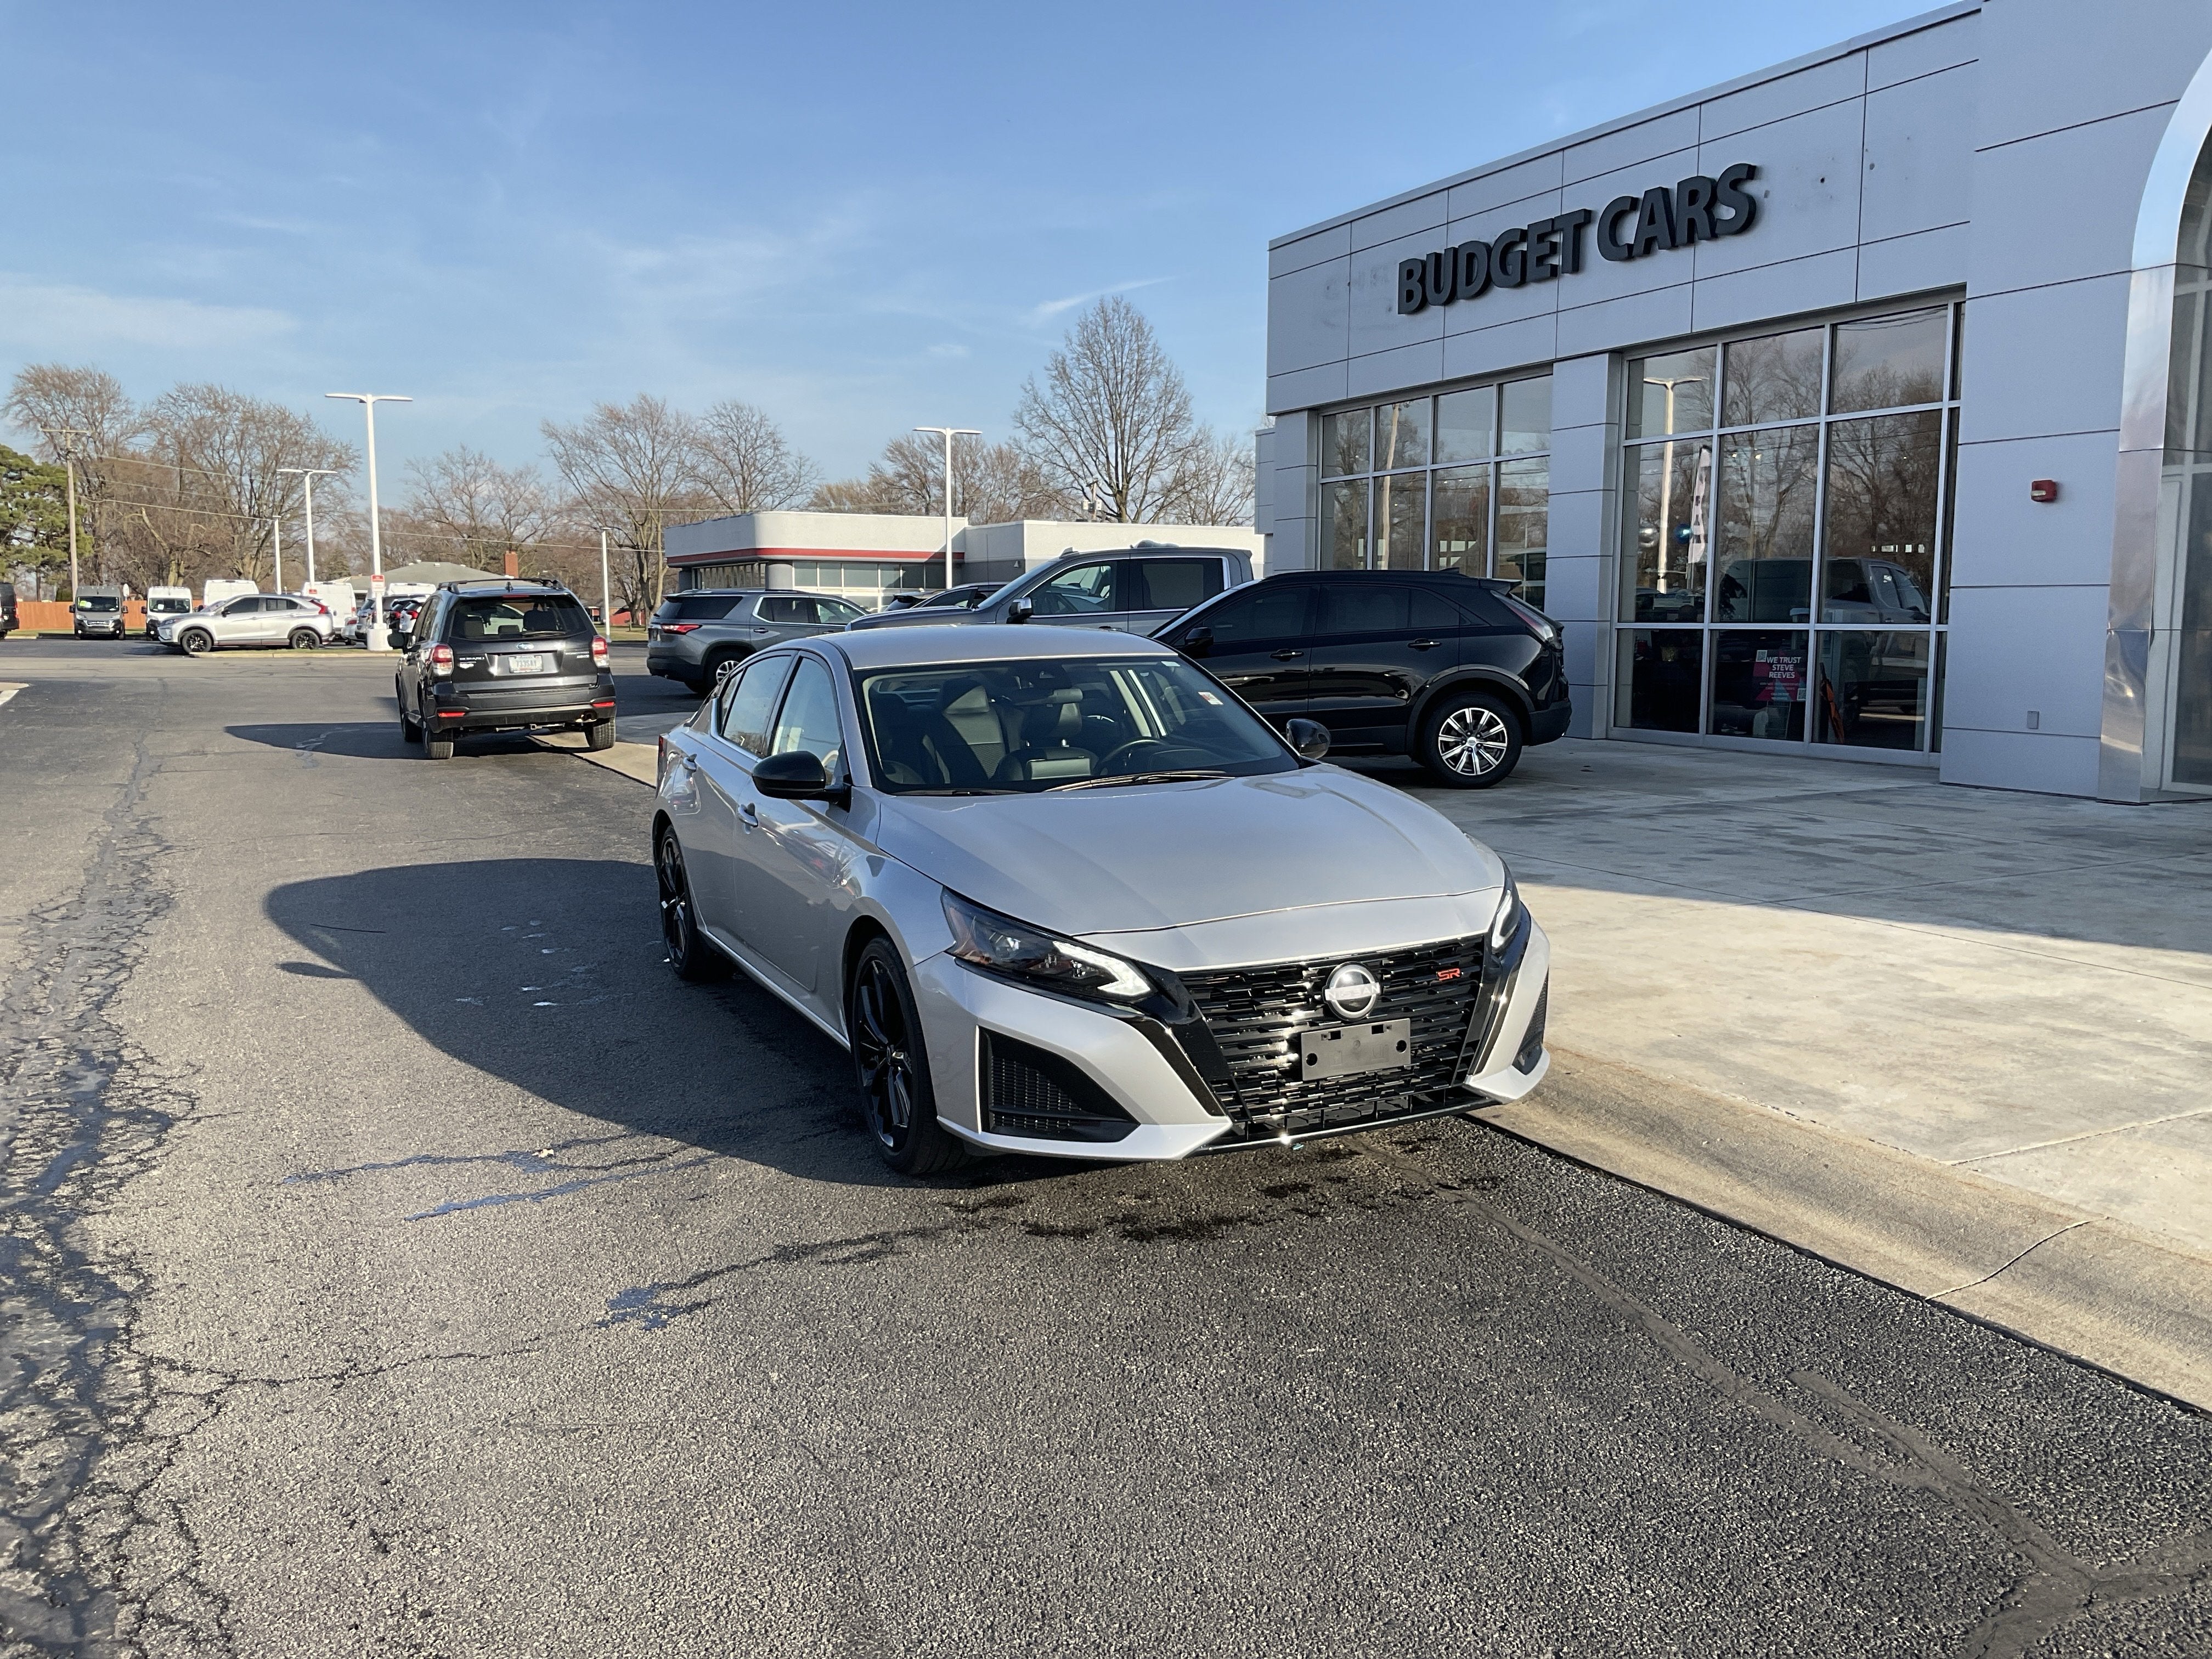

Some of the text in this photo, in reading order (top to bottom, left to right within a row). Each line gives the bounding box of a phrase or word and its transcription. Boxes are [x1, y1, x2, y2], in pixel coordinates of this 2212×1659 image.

[1398, 163, 1757, 315] BUDGET CARS
[1437, 968, 1460, 981] SR
[1326, 983, 1380, 1000] NISSAN
